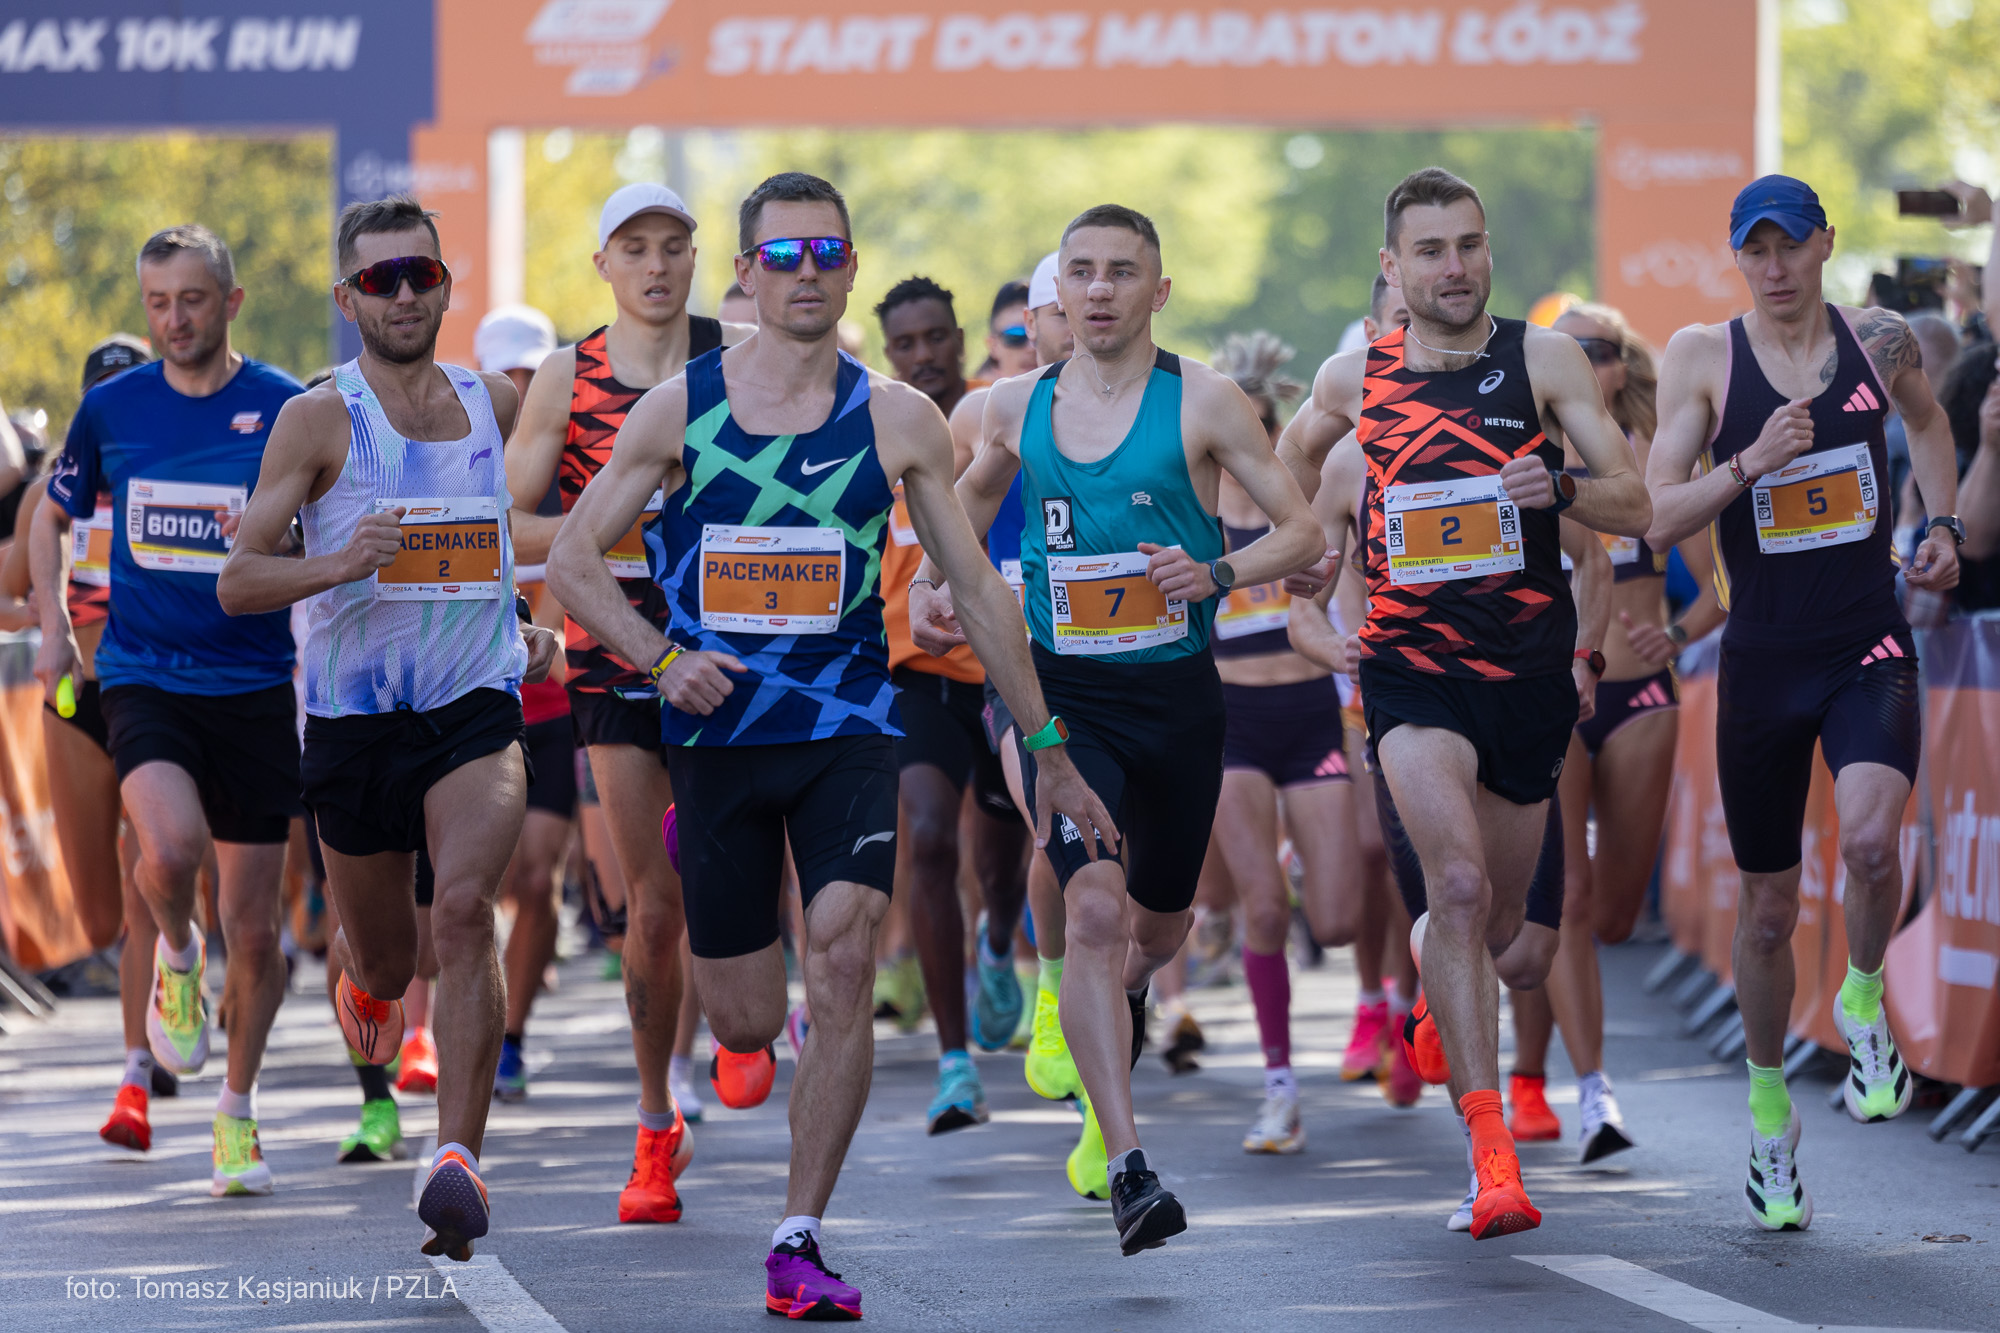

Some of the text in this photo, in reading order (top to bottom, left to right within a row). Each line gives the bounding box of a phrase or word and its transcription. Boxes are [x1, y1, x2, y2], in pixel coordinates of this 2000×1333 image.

[116, 18, 222, 72] 10K
[225, 17, 362, 72] RUN
[706, 16, 929, 75] START
[932, 13, 1090, 71] DOZ
[1094, 9, 1443, 67] MARATON
[1450, 1, 1645, 64] ŁÓDŹ
[1484, 417, 1524, 429] NETBOX
[1806, 487, 1828, 516] 5
[399, 531, 498, 551] ACEMAKER
[1440, 516, 1462, 546] 2
[1790, 528, 1811, 536] STARTU
[439, 560, 450, 577] 2
[706, 561, 838, 582] PACEMAKER
[1398, 560, 1420, 568] STREFA
[1420, 558, 1443, 566] STARTU
[765, 591, 778, 610] 3
[1105, 587, 1125, 617] 7
